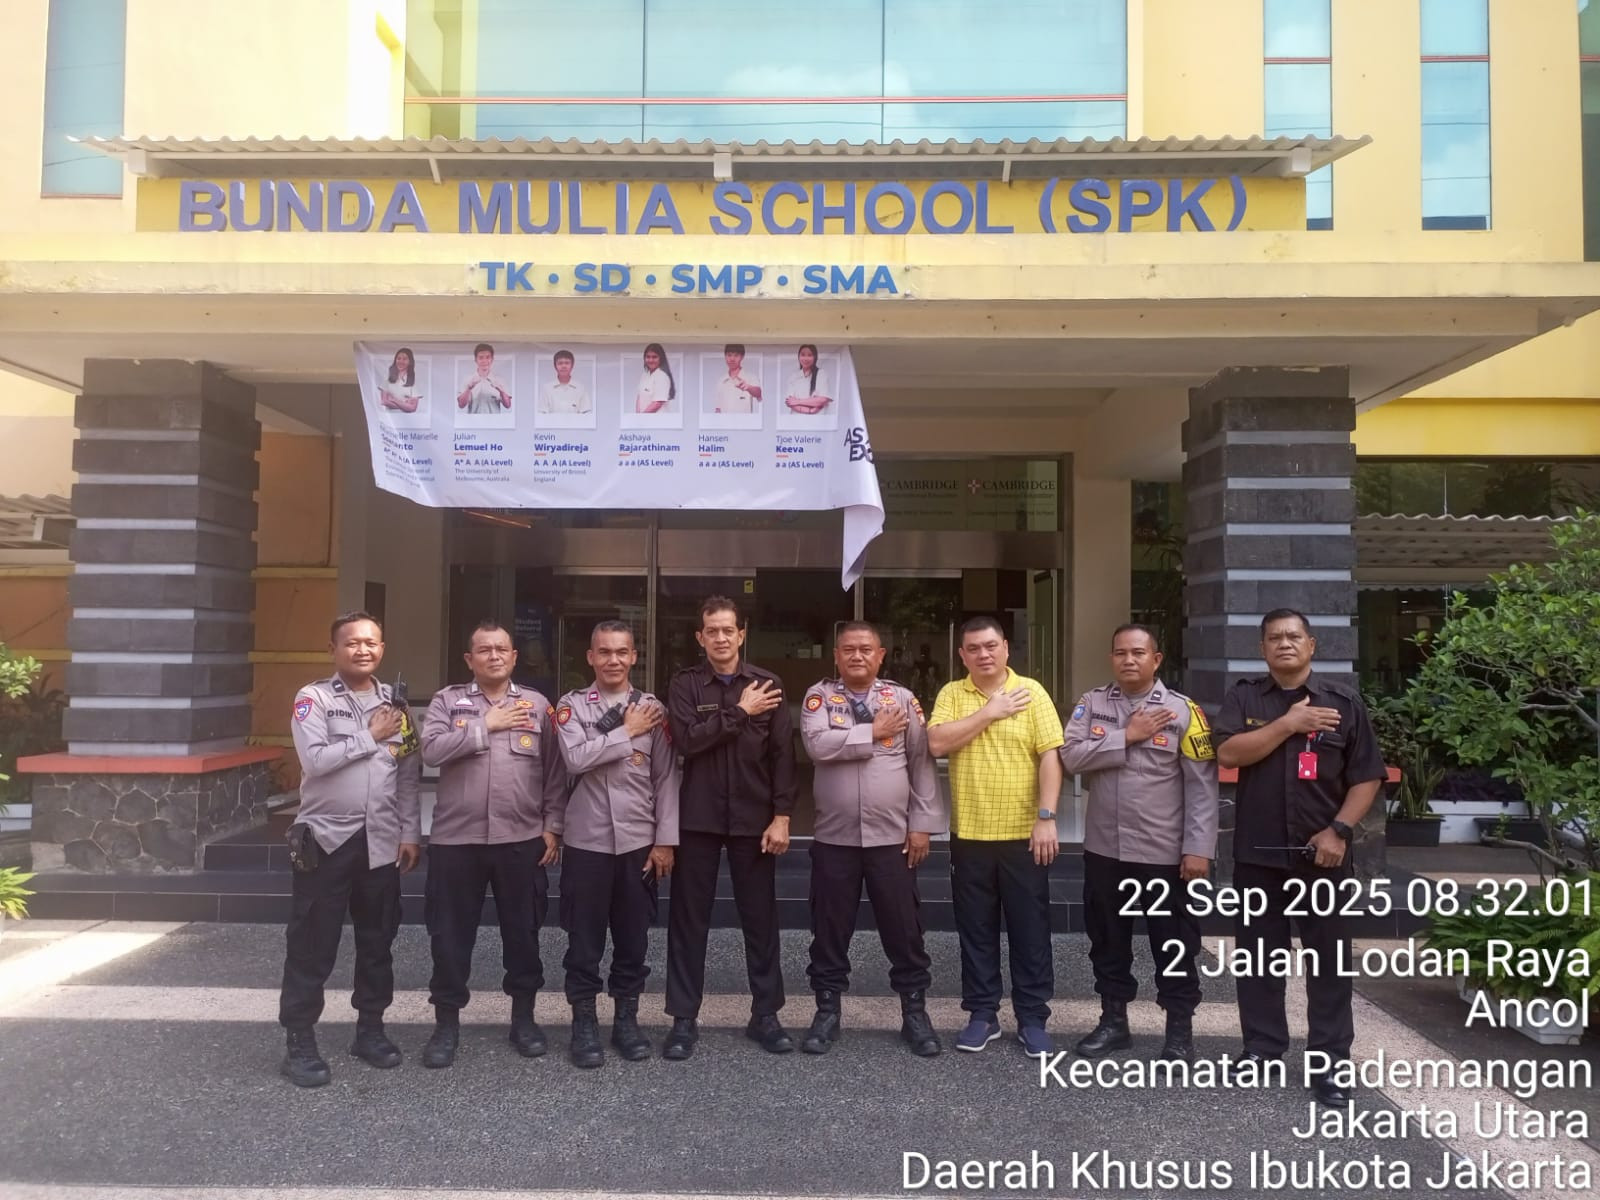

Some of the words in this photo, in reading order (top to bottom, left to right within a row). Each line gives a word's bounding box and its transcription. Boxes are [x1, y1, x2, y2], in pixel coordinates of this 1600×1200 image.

[179, 180, 430, 233] BUNDA
[458, 180, 686, 235] MULIA
[709, 181, 1014, 235] SCHOOL
[1039, 175, 1247, 233] (SPK)
[479, 262, 534, 292] TK
[573, 263, 631, 294] SD
[671, 264, 763, 294] SMP
[803, 265, 898, 295] SMA
[454, 433, 477, 442] Julian
[534, 433, 556, 441] Kevin
[618, 434, 652, 443] Akshaya
[776, 436, 793, 445] Tjoe
[794, 435, 822, 444] Valerie
[454, 443, 488, 451] Lemuel
[490, 443, 503, 451] Ho
[534, 443, 589, 453] Wiryadireja
[619, 443, 680, 453] Rajarathinam
[698, 444, 725, 453] Halim
[776, 445, 804, 453] Keeva
[490, 459, 513, 467] Level)
[569, 459, 591, 467] Level)
[802, 461, 825, 469] Level)
[887, 479, 960, 490] CAMBRIDGE
[982, 479, 1056, 490] CAMBRIDGE
[327, 709, 354, 720] DIDIK
